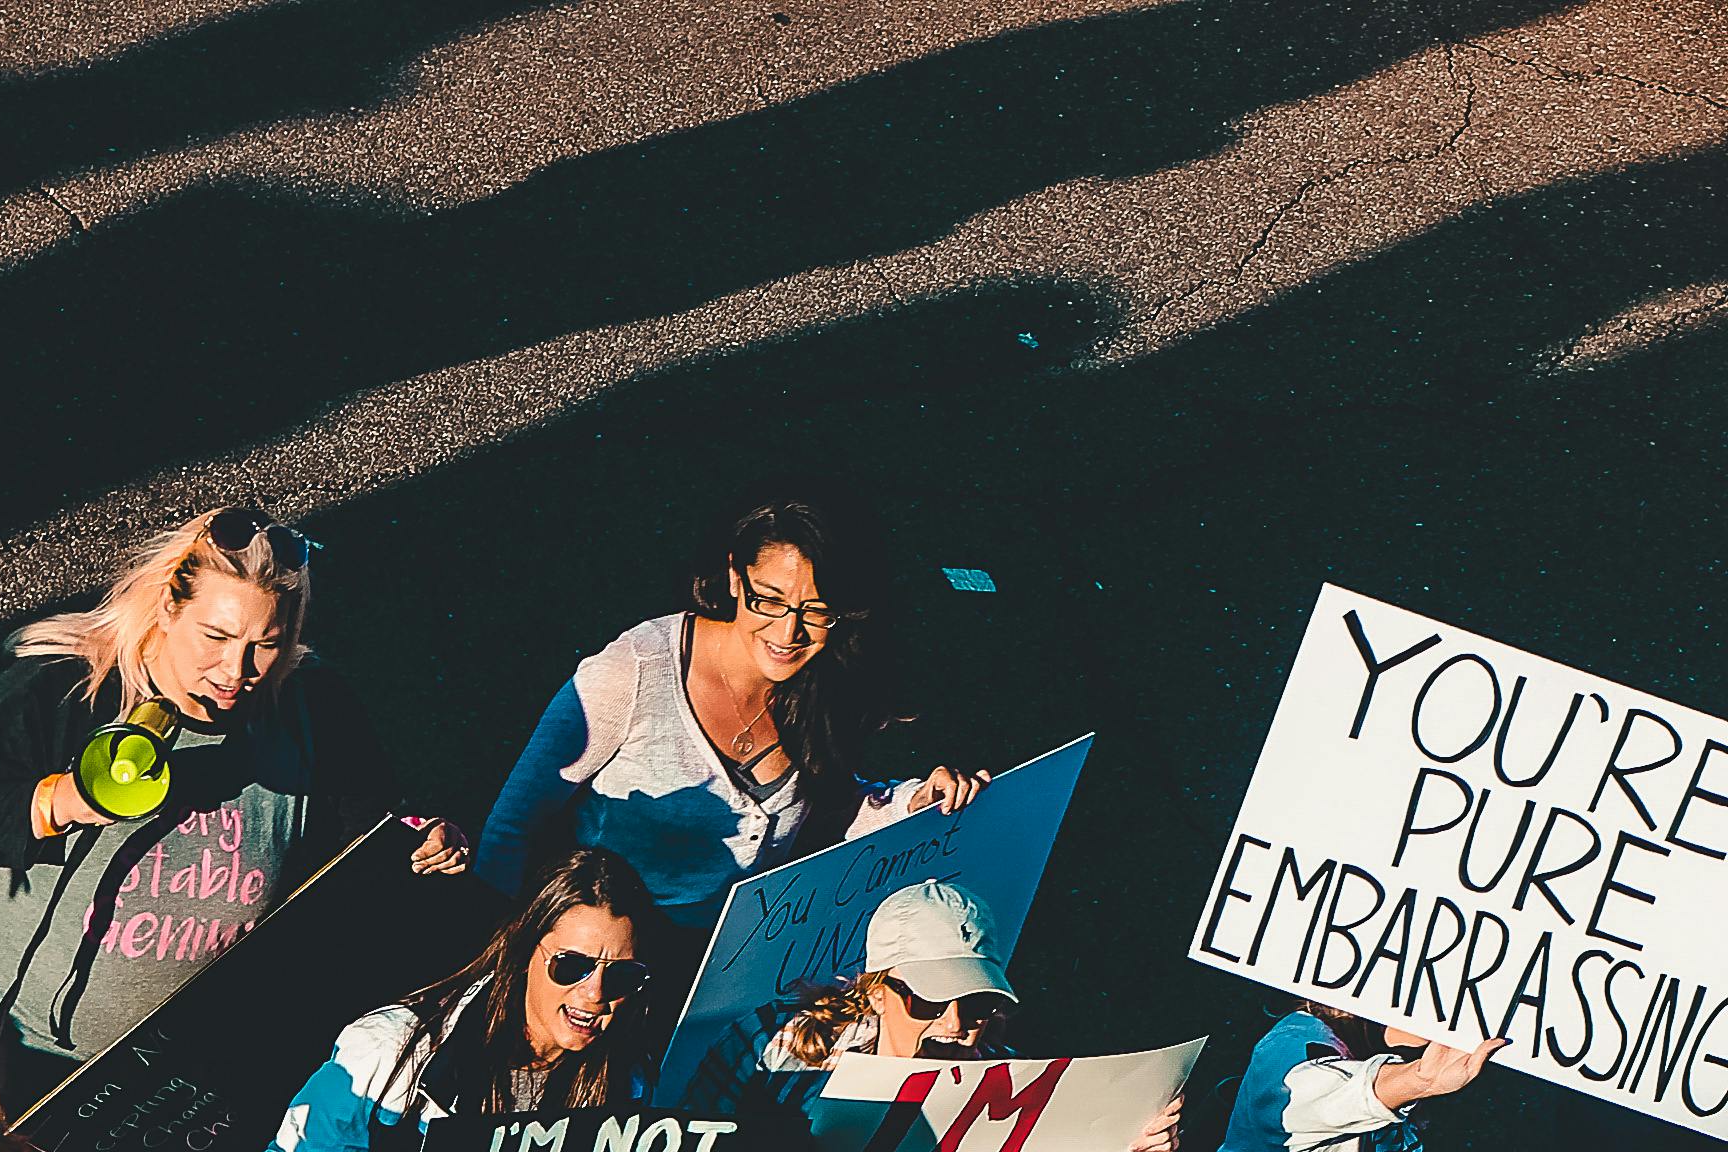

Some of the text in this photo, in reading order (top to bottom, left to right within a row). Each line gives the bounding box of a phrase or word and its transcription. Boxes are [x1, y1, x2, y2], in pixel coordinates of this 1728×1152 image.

[1342, 608, 1728, 861] YOU'RE
[721, 872, 817, 972] You
[1391, 767, 1672, 952] PURE
[1199, 833, 1728, 1118] EMBARRASSING
[76, 1081, 123, 1120] am
